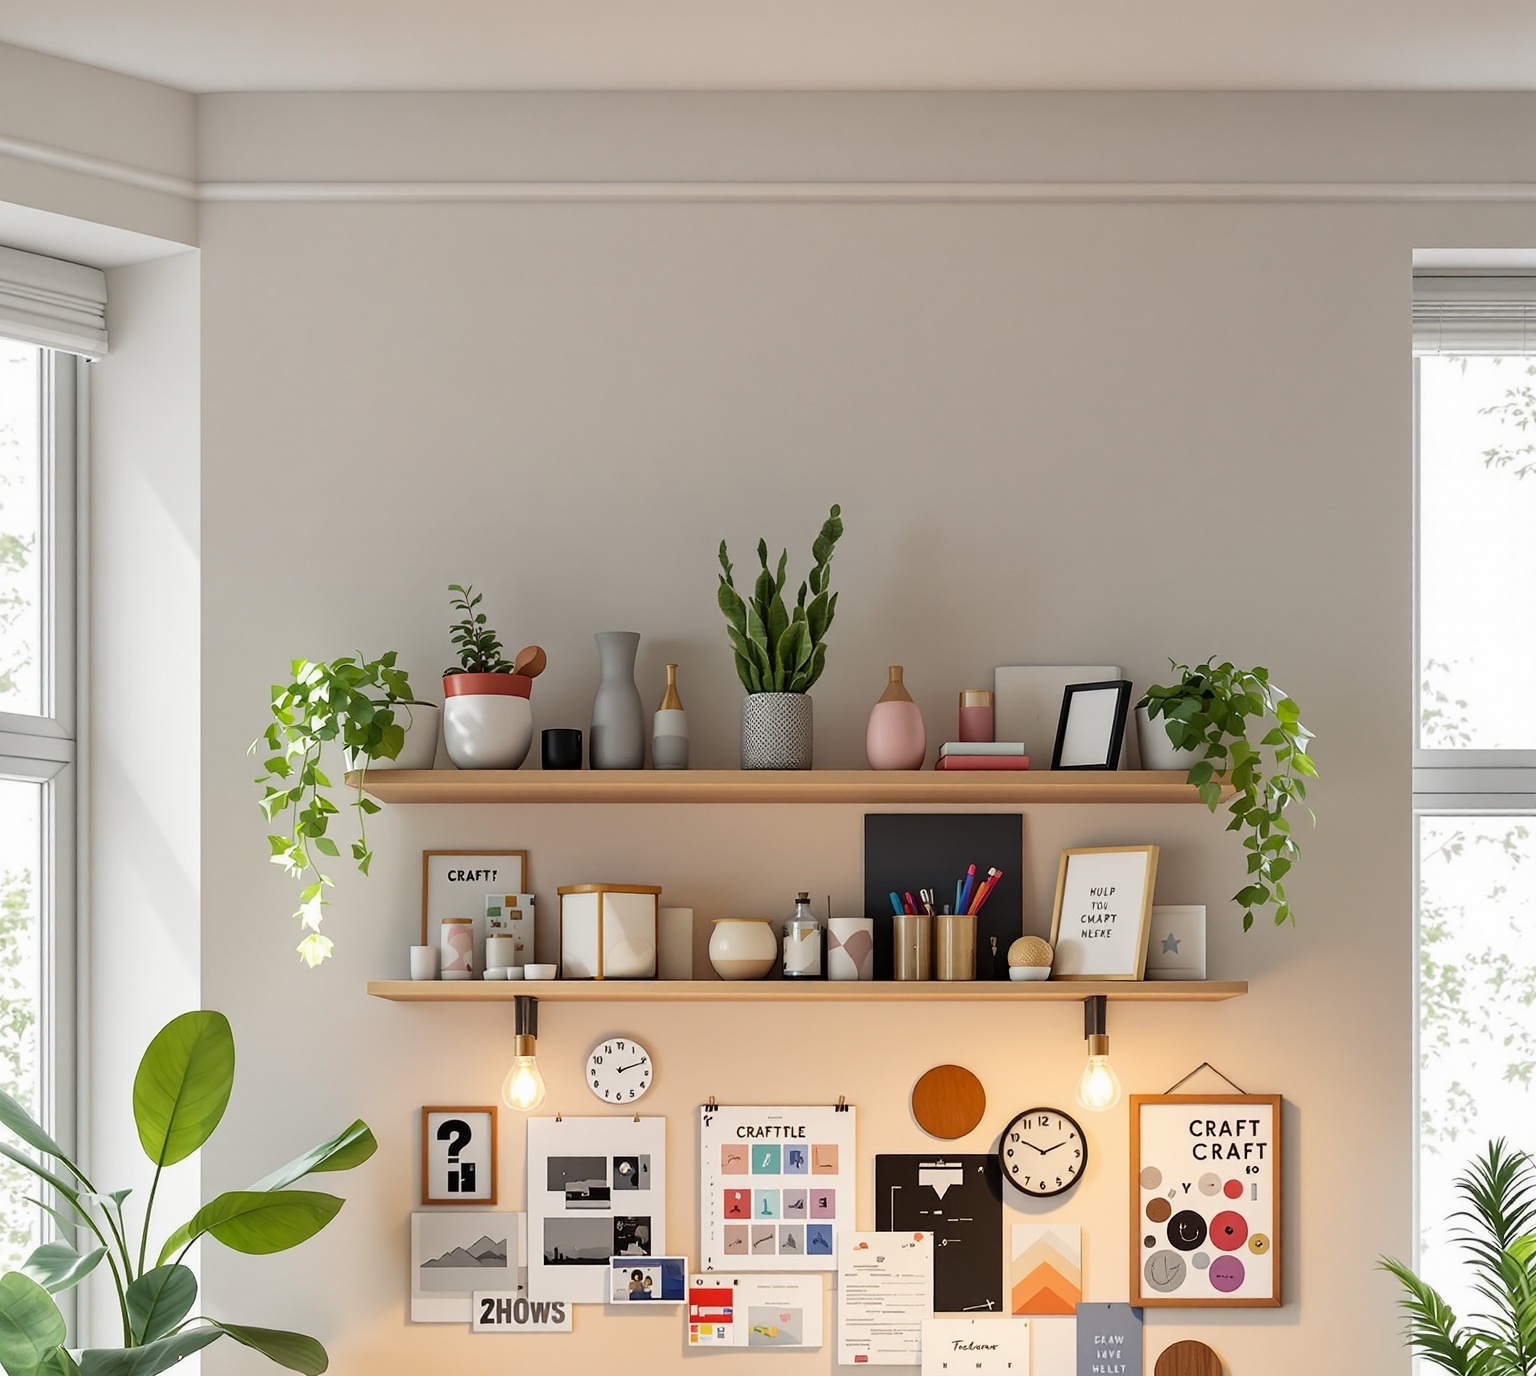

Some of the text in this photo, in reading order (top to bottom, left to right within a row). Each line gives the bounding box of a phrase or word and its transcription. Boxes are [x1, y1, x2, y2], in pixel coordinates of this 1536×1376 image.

[592, 1055, 603, 1065] 10
[616, 1092, 622, 1101] 6
[630, 1089, 635, 1098] 5
[1023, 1119, 1032, 1130] 11
[1038, 1116, 1050, 1127] 12
[1058, 1120, 1062, 1131] 1
[1189, 1119, 1260, 1137] CRAFT
[1192, 1142, 1268, 1161] CRAFT
[1025, 1176, 1031, 1187] 7
[1039, 1181, 1046, 1191] 6
[1181, 1182, 1192, 1194] Y
[479, 1298, 566, 1325] 2HOWS
